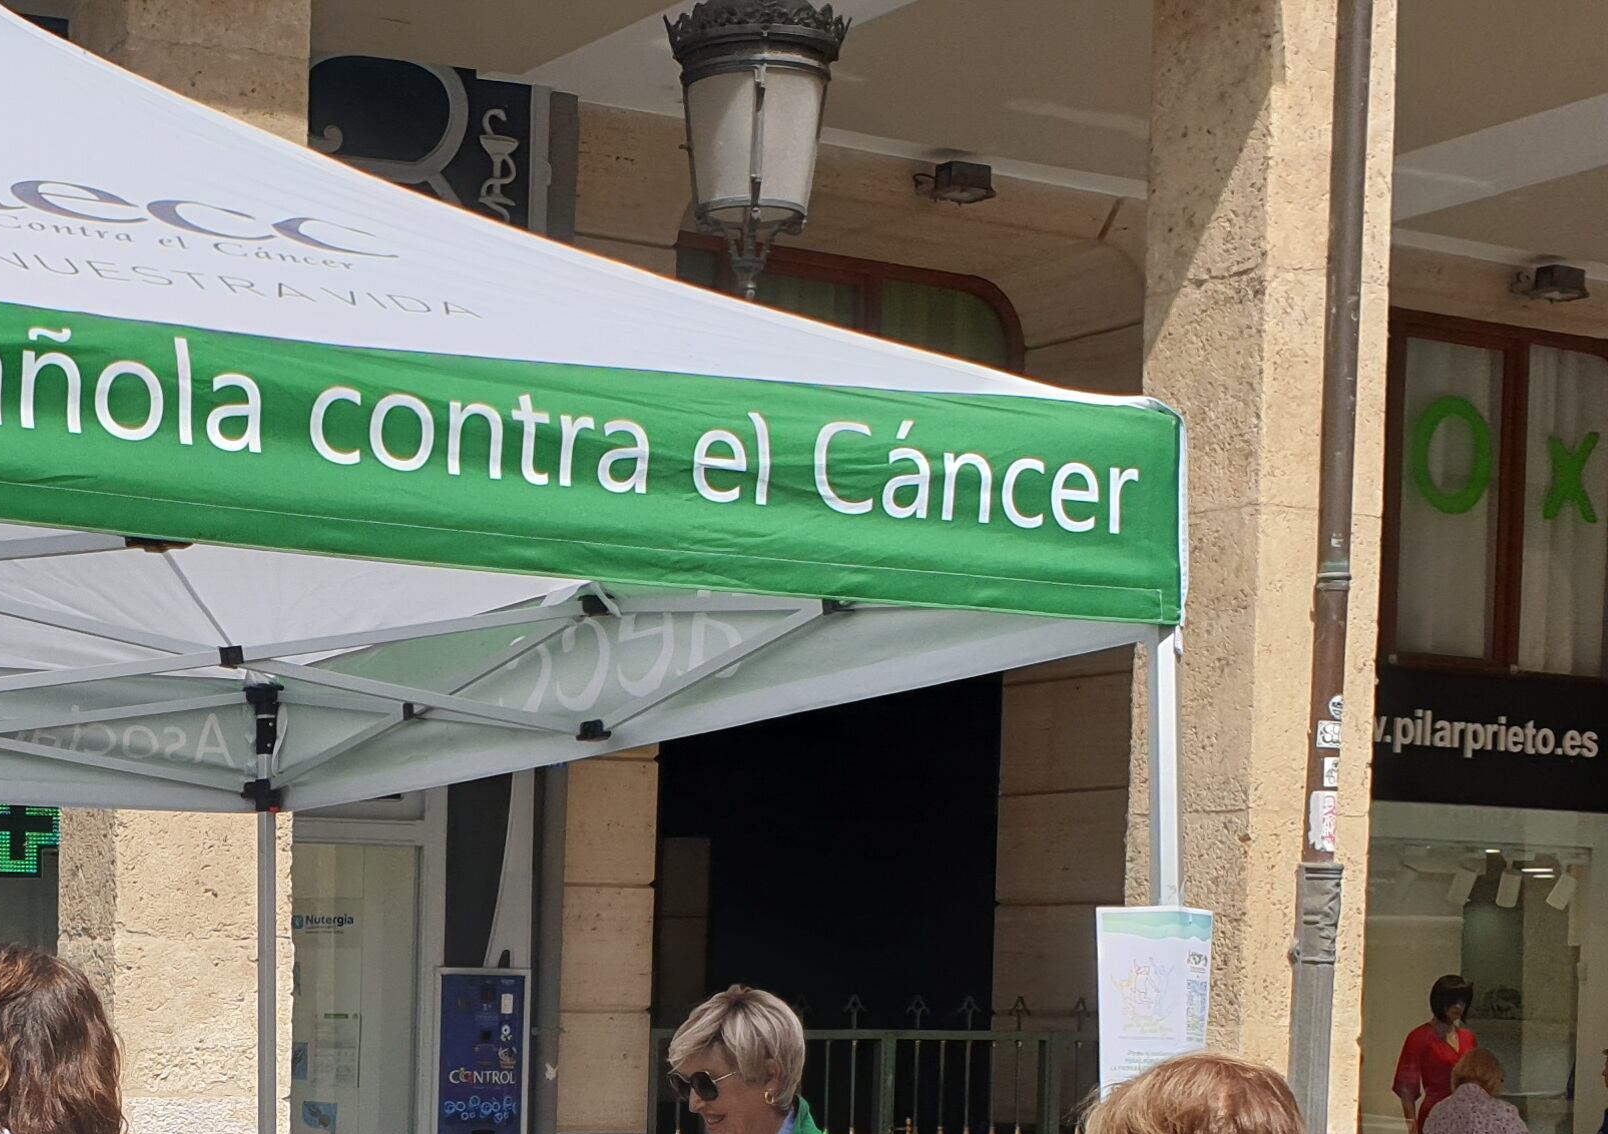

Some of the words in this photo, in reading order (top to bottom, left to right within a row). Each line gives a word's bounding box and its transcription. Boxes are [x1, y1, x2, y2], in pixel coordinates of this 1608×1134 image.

[159, 235, 190, 250] el
[213, 241, 354, 271] Cáncer
[320, 286, 484, 319] VIDA
[309, 386, 649, 495] contra
[693, 412, 770, 507] el
[813, 420, 1140, 535] Cáncer
[305, 913, 354, 927] Nutergia
[449, 1068, 516, 1085] CONTROL
